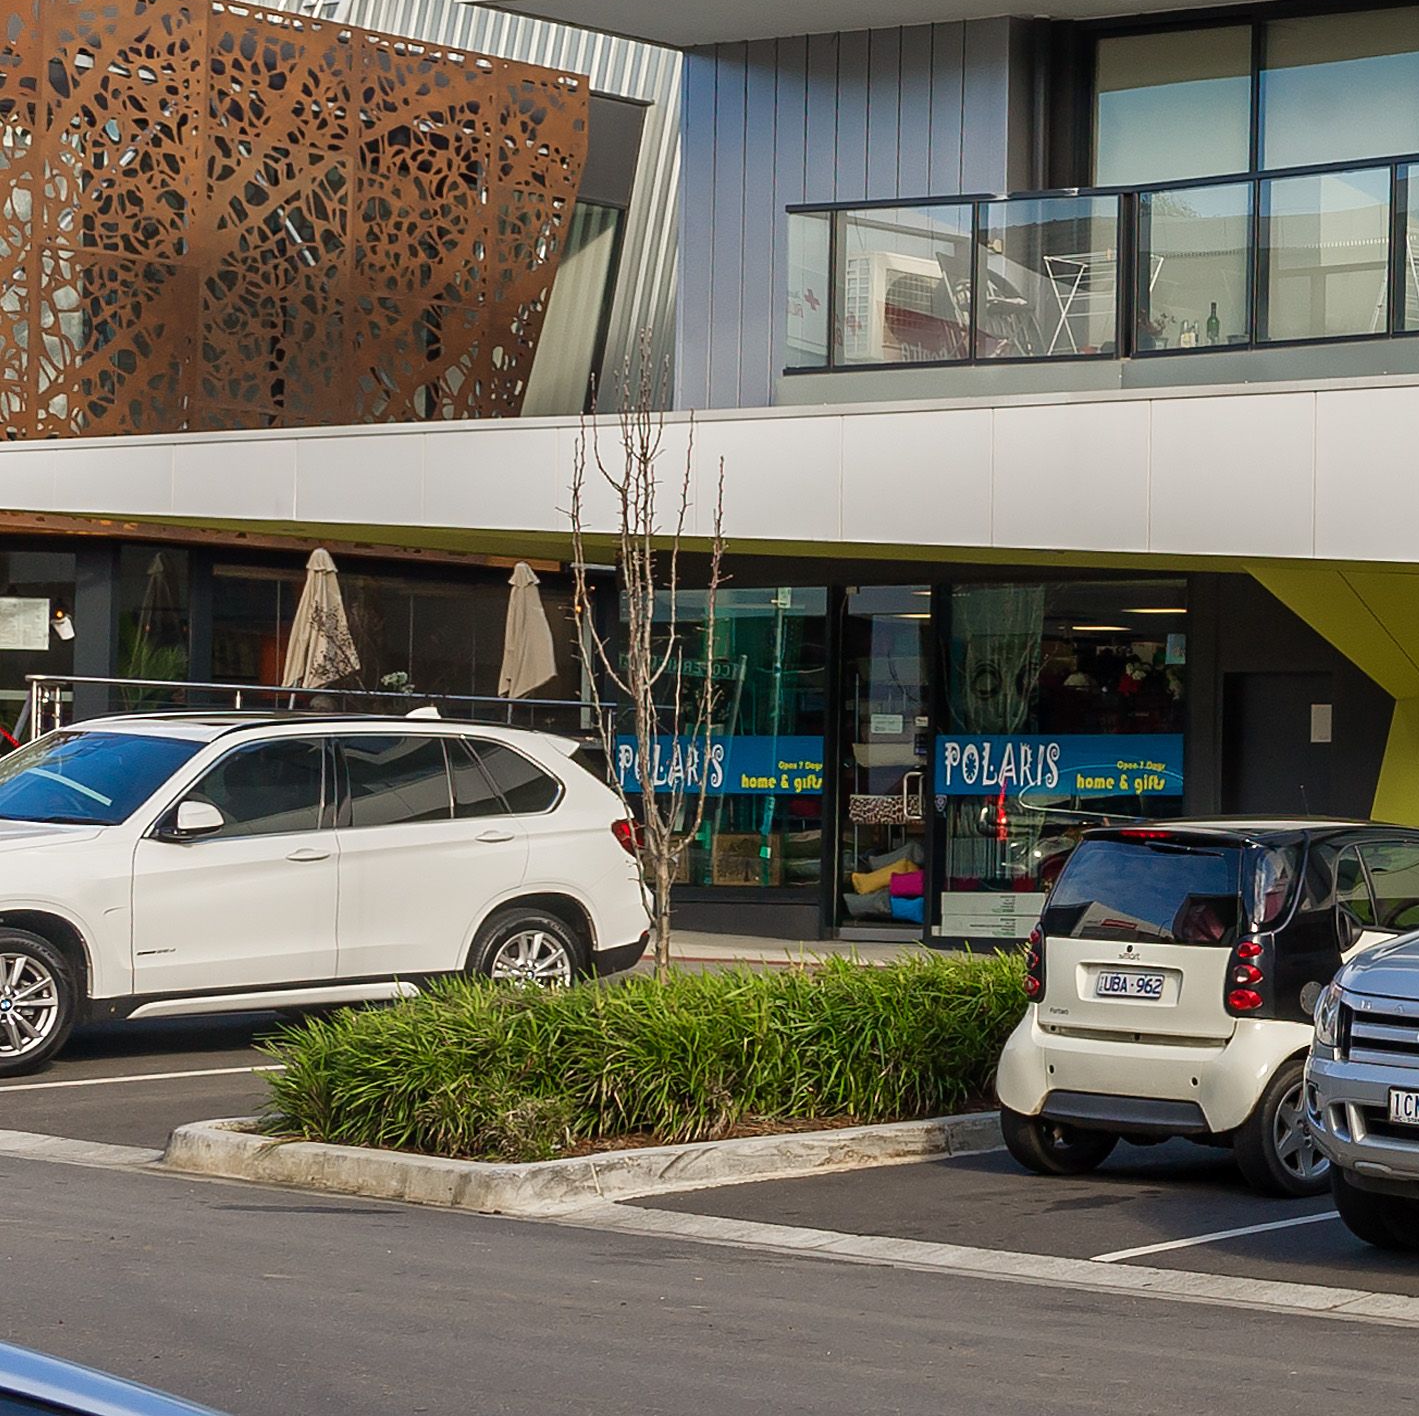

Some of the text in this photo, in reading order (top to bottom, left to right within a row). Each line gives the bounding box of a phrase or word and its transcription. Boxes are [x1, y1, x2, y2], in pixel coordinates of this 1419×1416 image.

[618, 744, 724, 788] PLARS
[944, 742, 1060, 788] POLARIS
[741, 773, 823, 793] home & gifts
[1076, 773, 1166, 794] home & gifts
